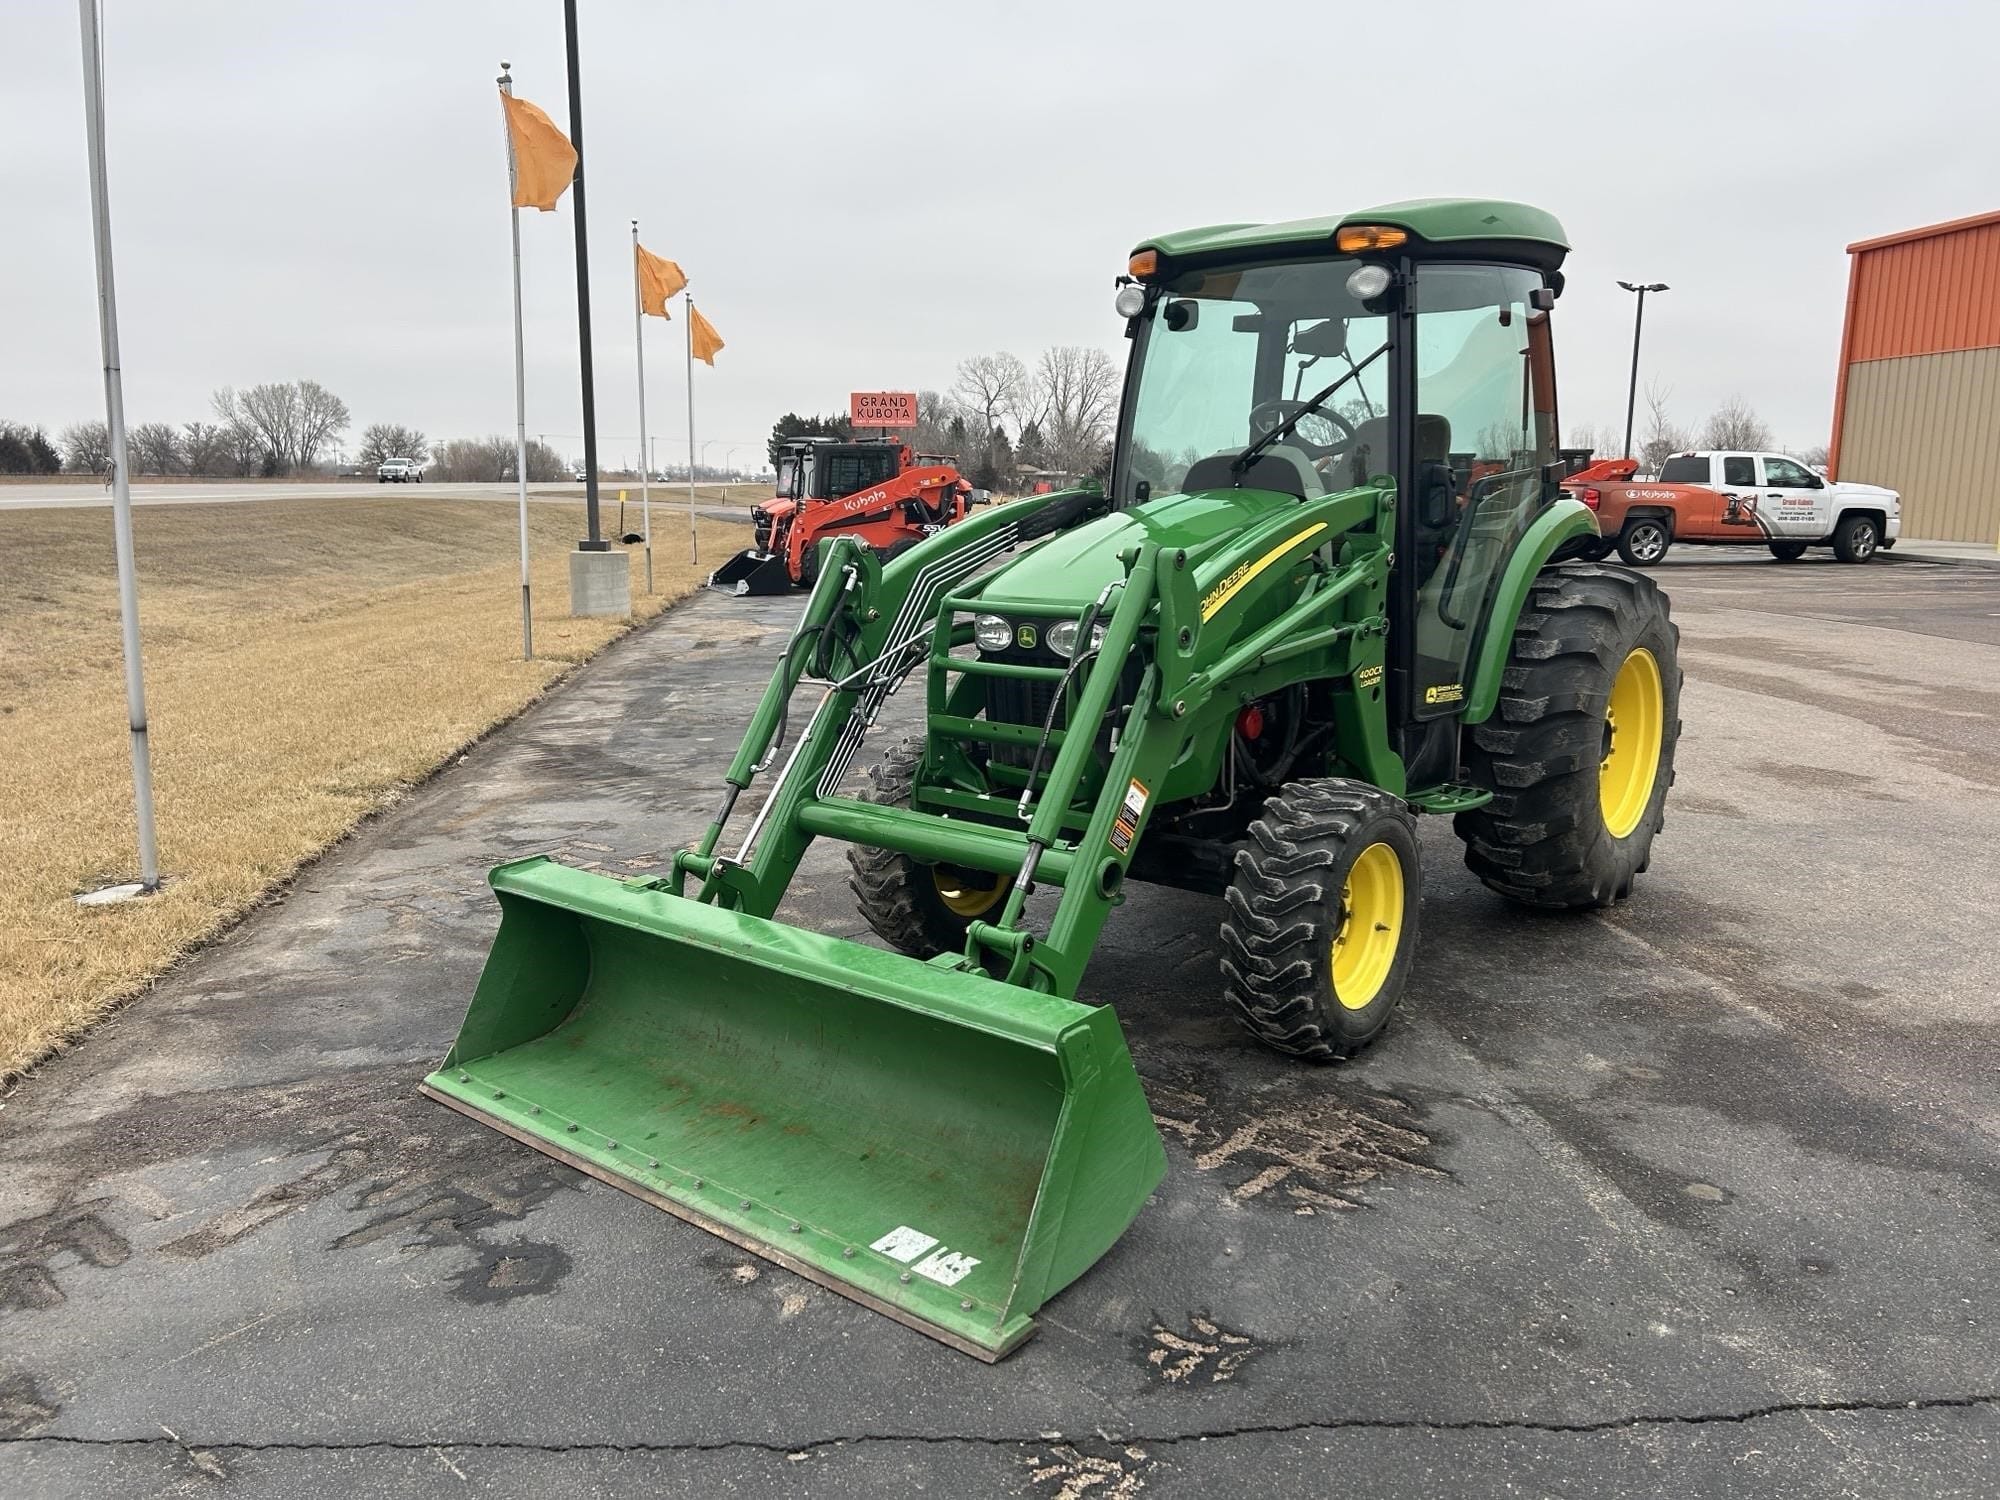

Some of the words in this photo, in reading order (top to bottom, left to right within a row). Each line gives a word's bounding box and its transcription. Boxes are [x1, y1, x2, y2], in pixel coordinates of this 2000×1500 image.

[860, 397, 908, 407] GRAND
[857, 408, 910, 418] KUBOTA
[843, 490, 887, 510] Kubota
[1641, 490, 1676, 499] Kubota
[1200, 587, 1220, 612] OHN
[1219, 560, 1250, 596] DEERE
[1359, 665, 1383, 679] 400CX
[1360, 676, 1381, 688] LOADER
